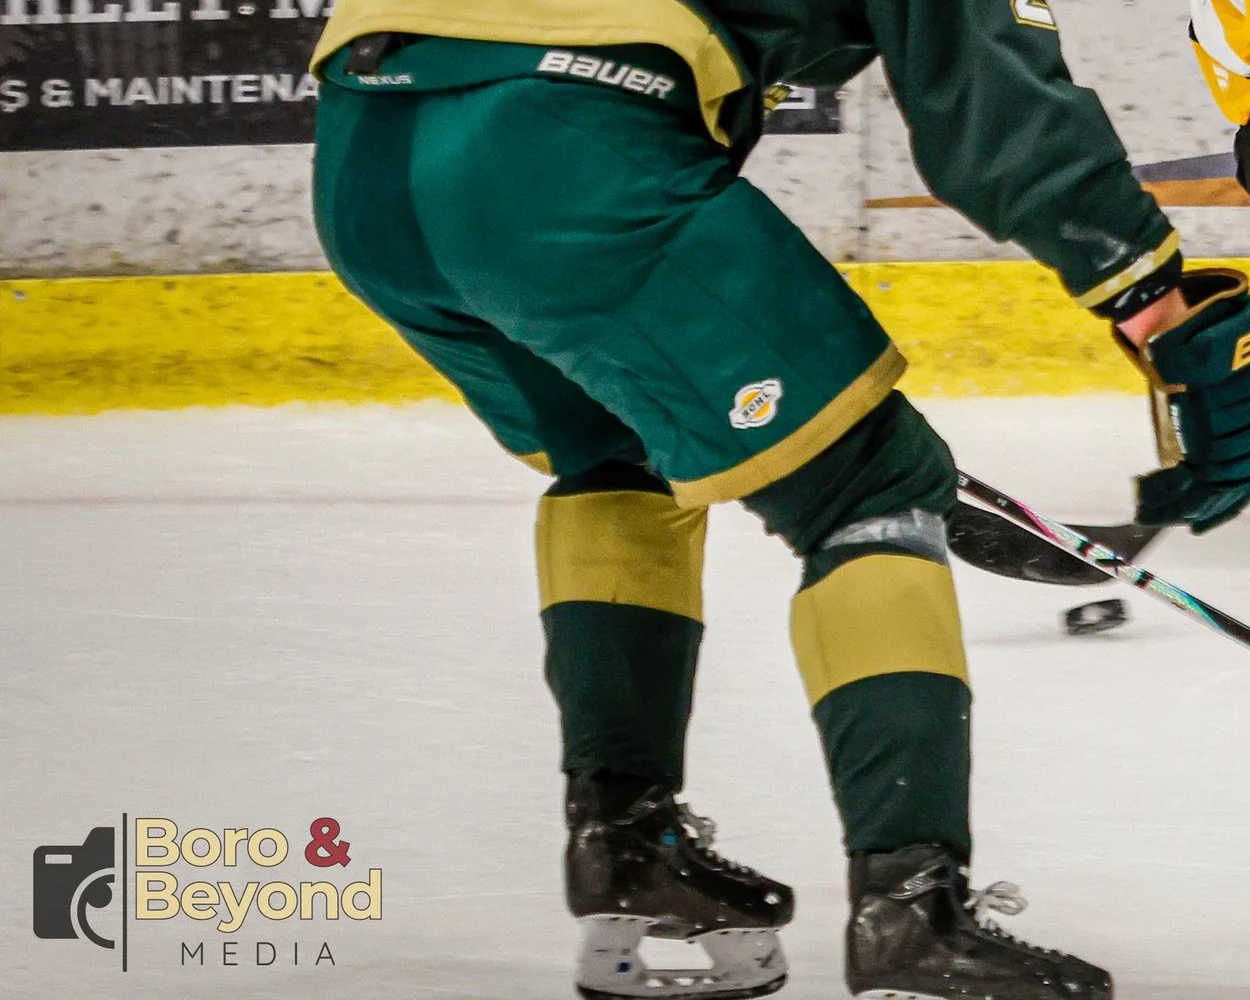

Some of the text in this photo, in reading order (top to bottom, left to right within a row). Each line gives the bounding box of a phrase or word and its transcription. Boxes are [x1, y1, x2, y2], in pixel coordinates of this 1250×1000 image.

[358, 73, 414, 86] NEXUS
[536, 50, 676, 100] BAUER
[40, 79, 74, 108] &
